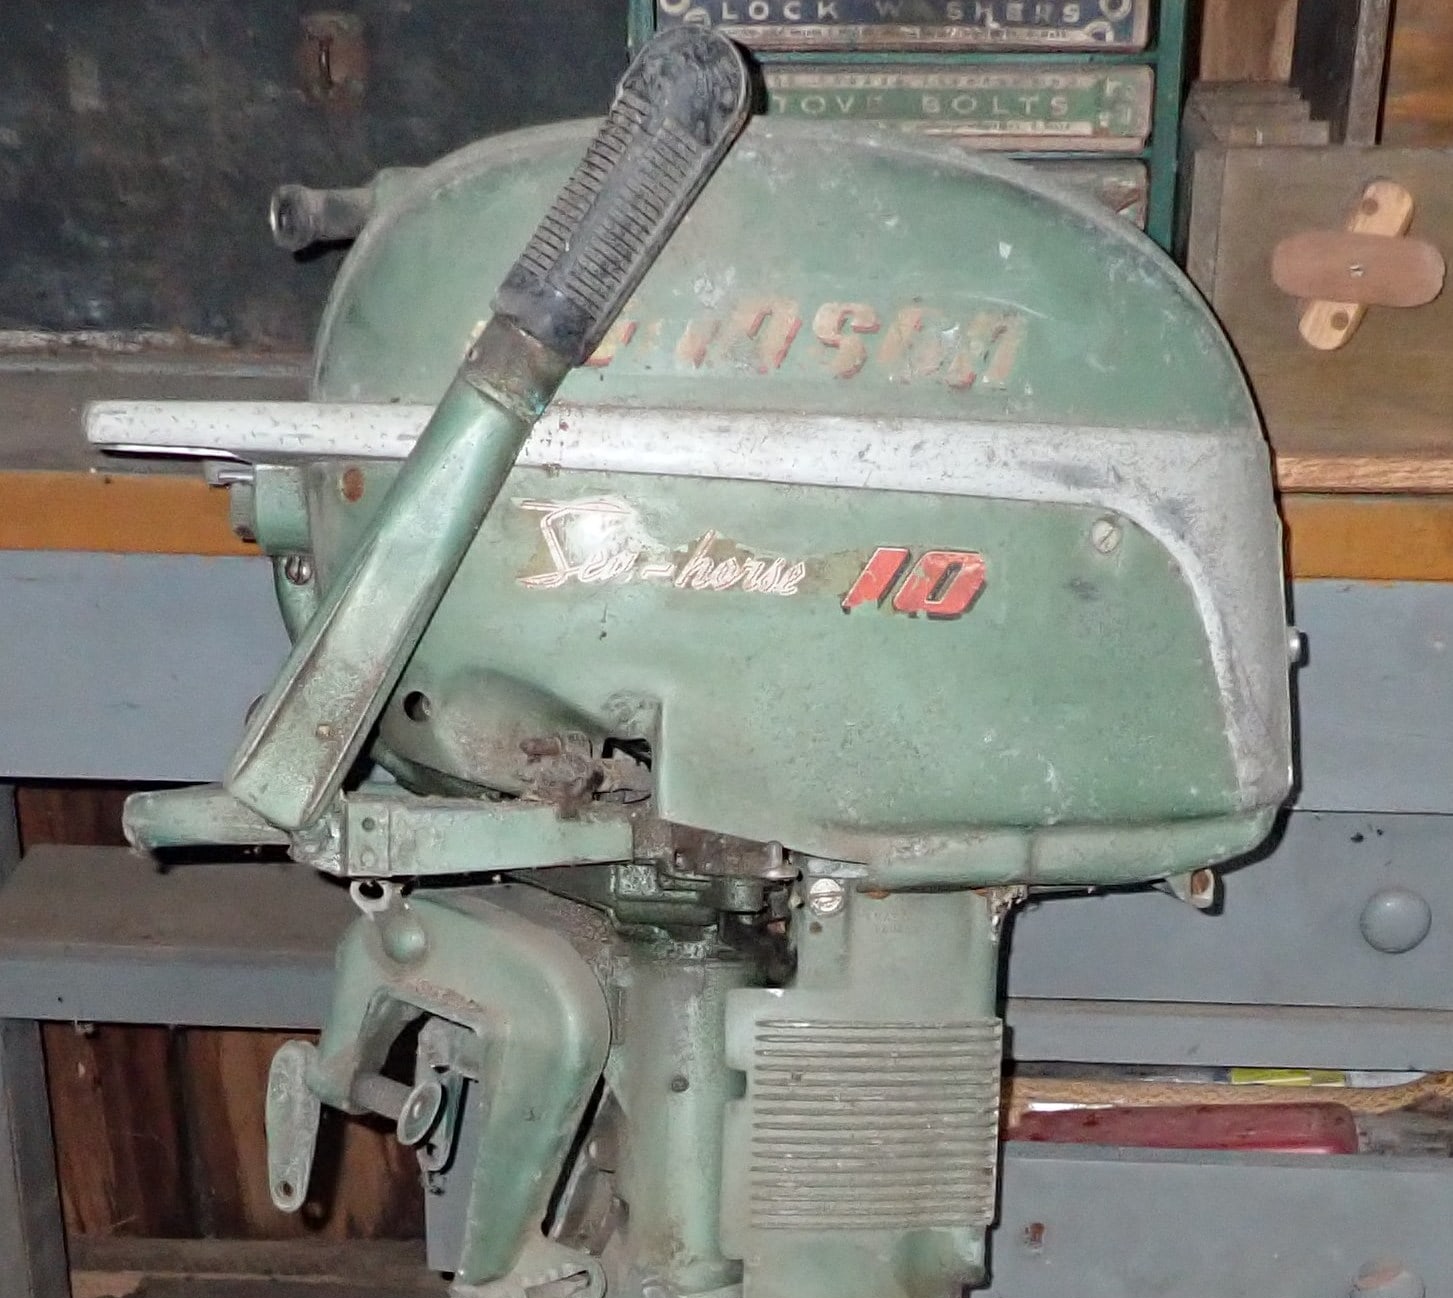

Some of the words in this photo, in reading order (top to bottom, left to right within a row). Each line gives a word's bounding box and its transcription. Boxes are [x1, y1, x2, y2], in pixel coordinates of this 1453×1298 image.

[721, 0, 839, 21] LOCK
[768, 94, 885, 116] TOVE
[920, 95, 1070, 118] BOLTS
[841, 546, 990, 621] 10
